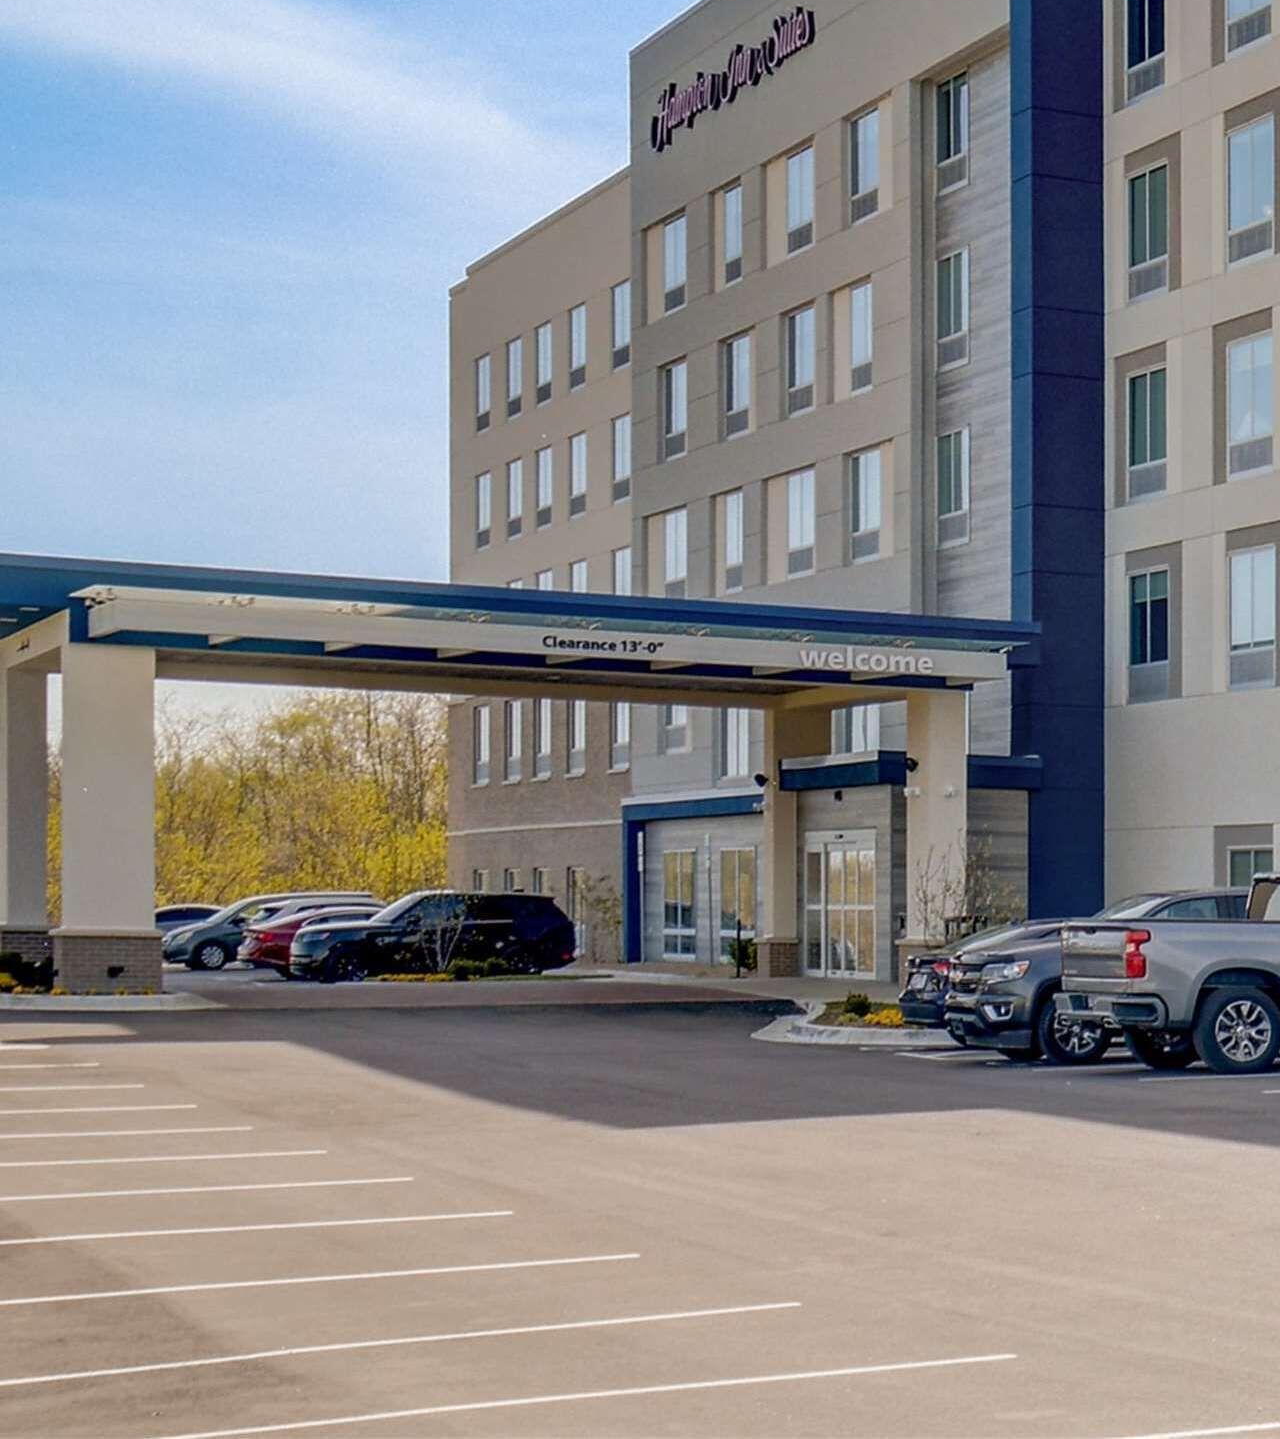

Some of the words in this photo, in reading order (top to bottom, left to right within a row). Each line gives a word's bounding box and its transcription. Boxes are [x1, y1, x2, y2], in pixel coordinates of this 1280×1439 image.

[652, 72, 721, 151] Hampton
[766, 7, 815, 68] Suites
[542, 635, 617, 651] Clearance
[800, 646, 933, 673] welcome
